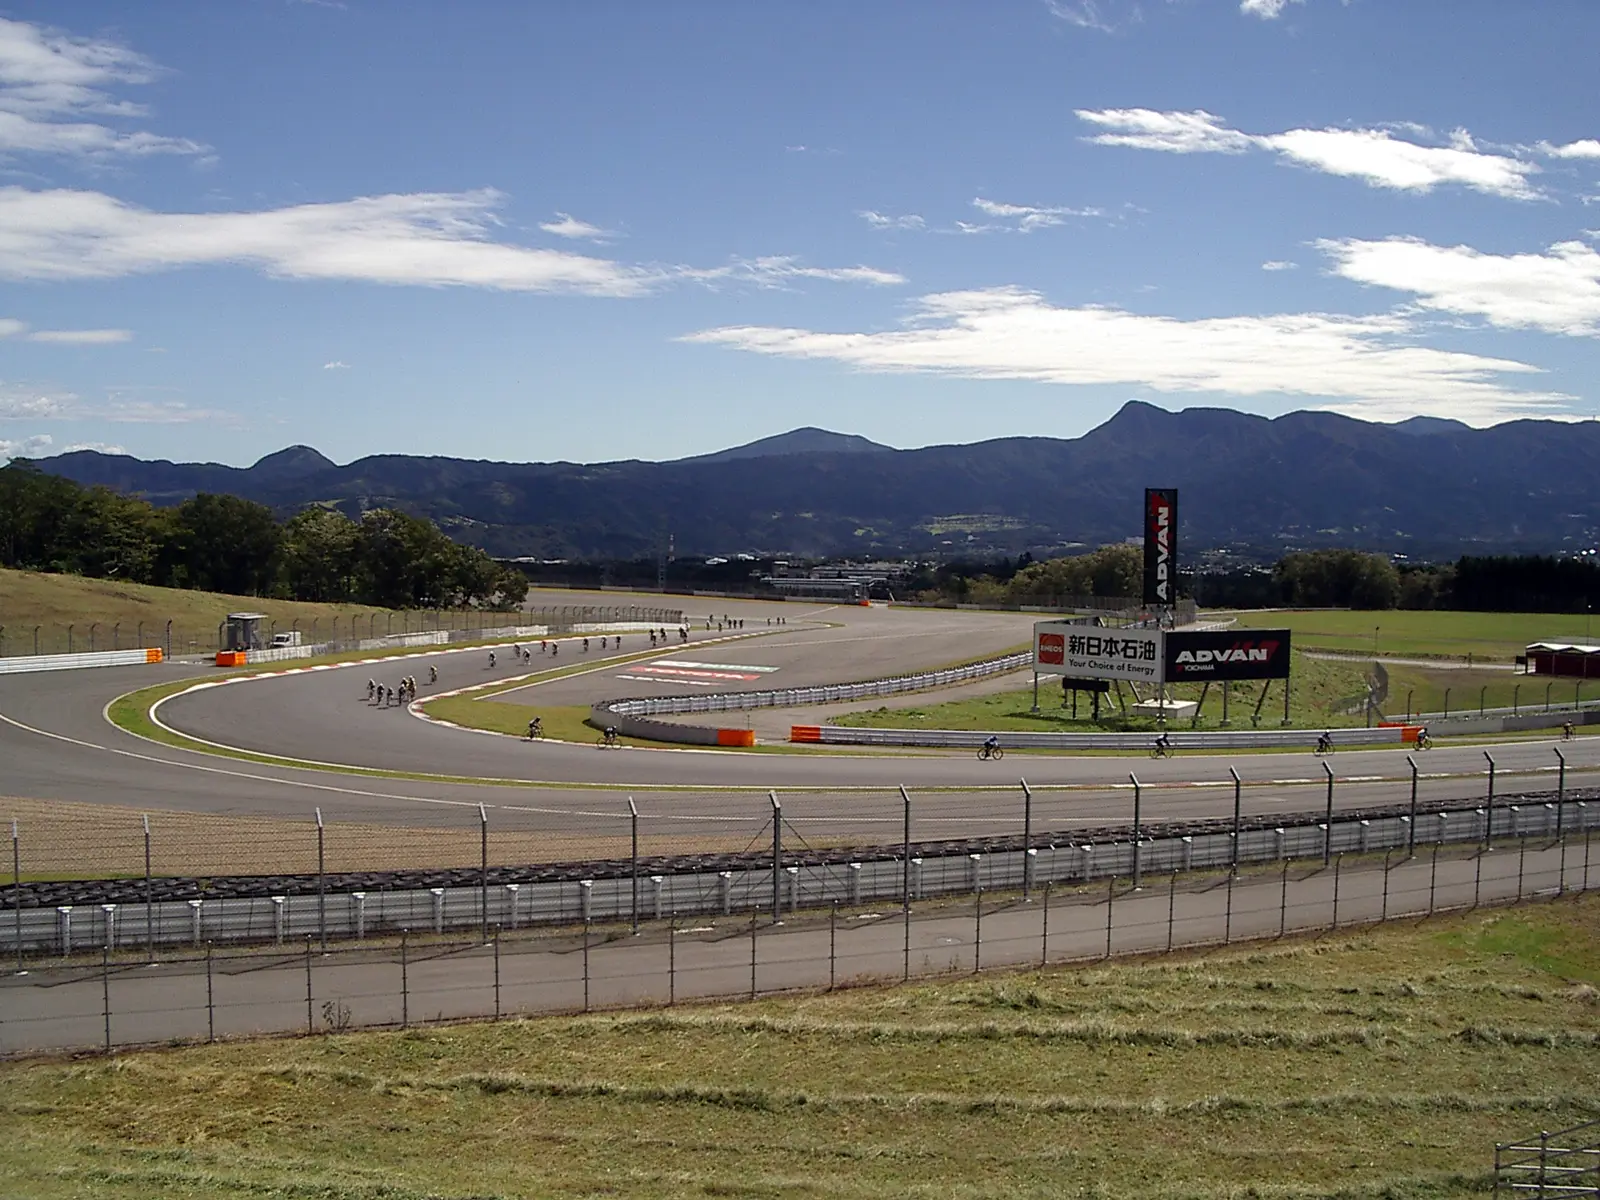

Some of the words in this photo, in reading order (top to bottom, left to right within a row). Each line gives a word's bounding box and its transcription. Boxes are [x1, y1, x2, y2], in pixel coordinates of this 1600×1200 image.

[1156, 506, 1169, 601] ADVAN
[1068, 634, 1156, 660] 新日本石油
[1175, 648, 1268, 663] ADVAN
[1069, 658, 1086, 668] Your
[1088, 660, 1114, 670] Choice
[1116, 662, 1125, 671] of
[1127, 663, 1155, 676] Energy
